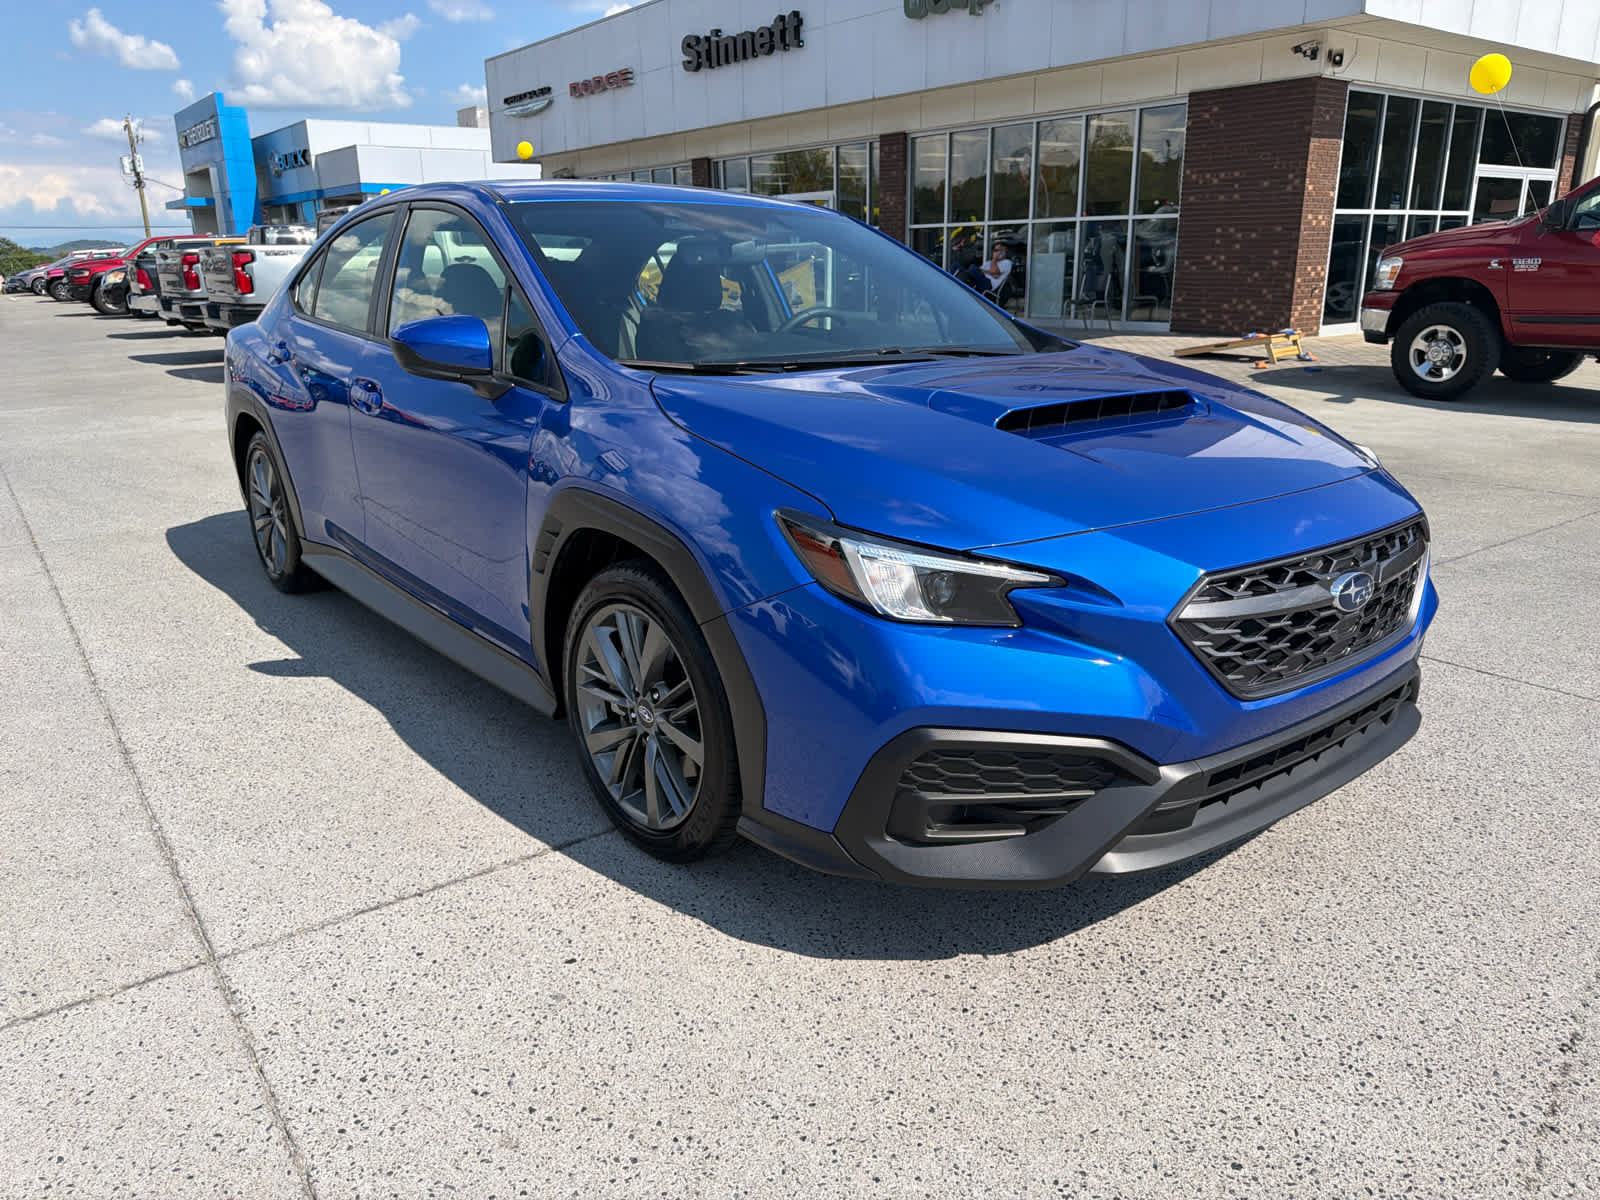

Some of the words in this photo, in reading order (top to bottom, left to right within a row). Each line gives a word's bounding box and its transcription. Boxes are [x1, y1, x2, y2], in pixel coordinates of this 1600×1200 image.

[681, 10, 803, 72] Stinnett
[568, 69, 633, 98] DODGE
[277, 149, 309, 170] BUICK
